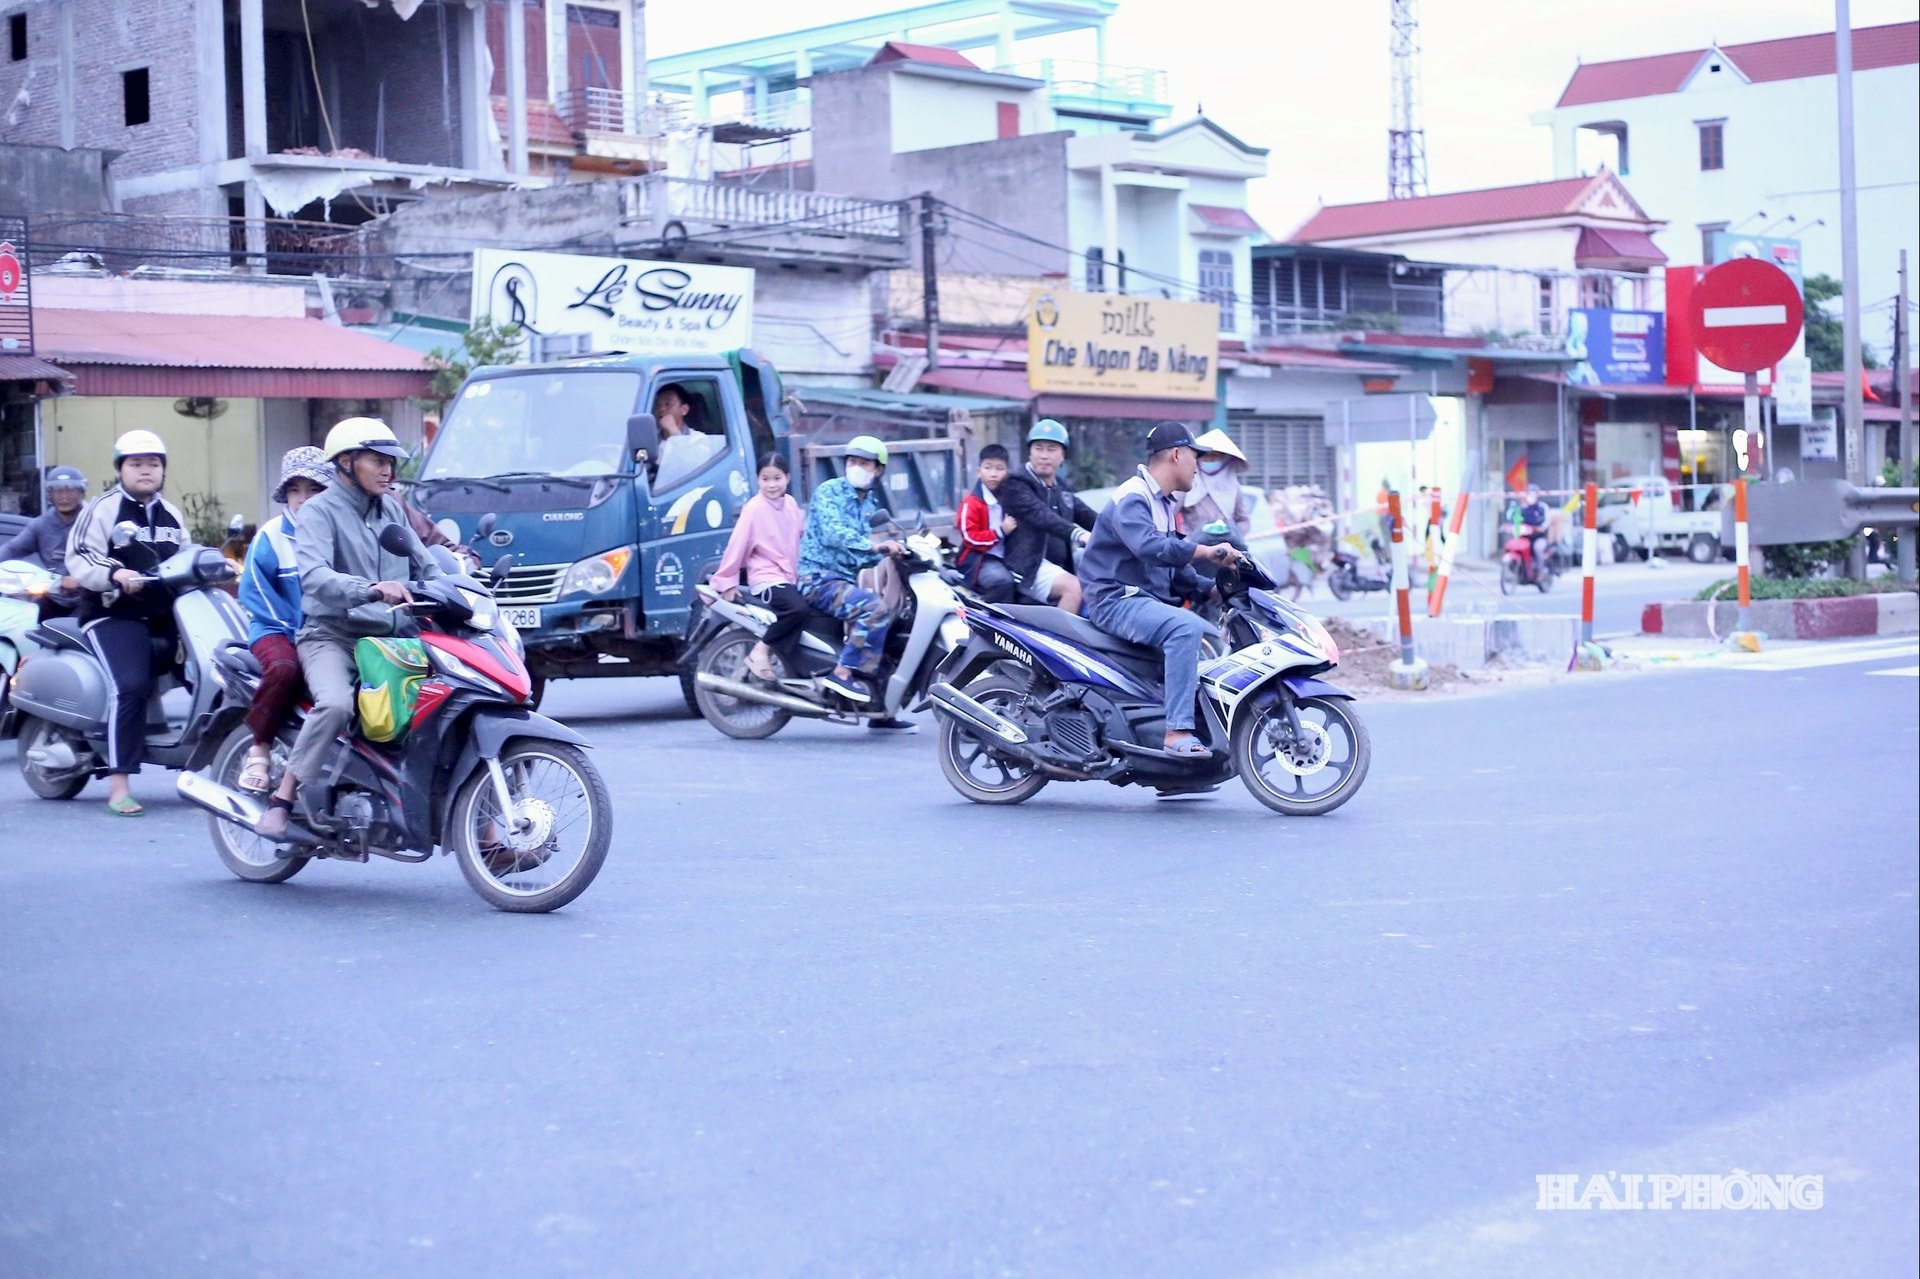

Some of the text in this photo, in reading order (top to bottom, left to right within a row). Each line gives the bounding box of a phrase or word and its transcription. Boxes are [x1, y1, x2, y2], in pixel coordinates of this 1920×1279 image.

[567, 264, 743, 329] Lê Sunny
[618, 314, 700, 333] Beauty & Spa
[1101, 299, 1155, 337] milk
[1083, 341, 1130, 376] Ngon
[994, 631, 1033, 667] YAMAHA
[421, 684, 445, 696] HONDA
